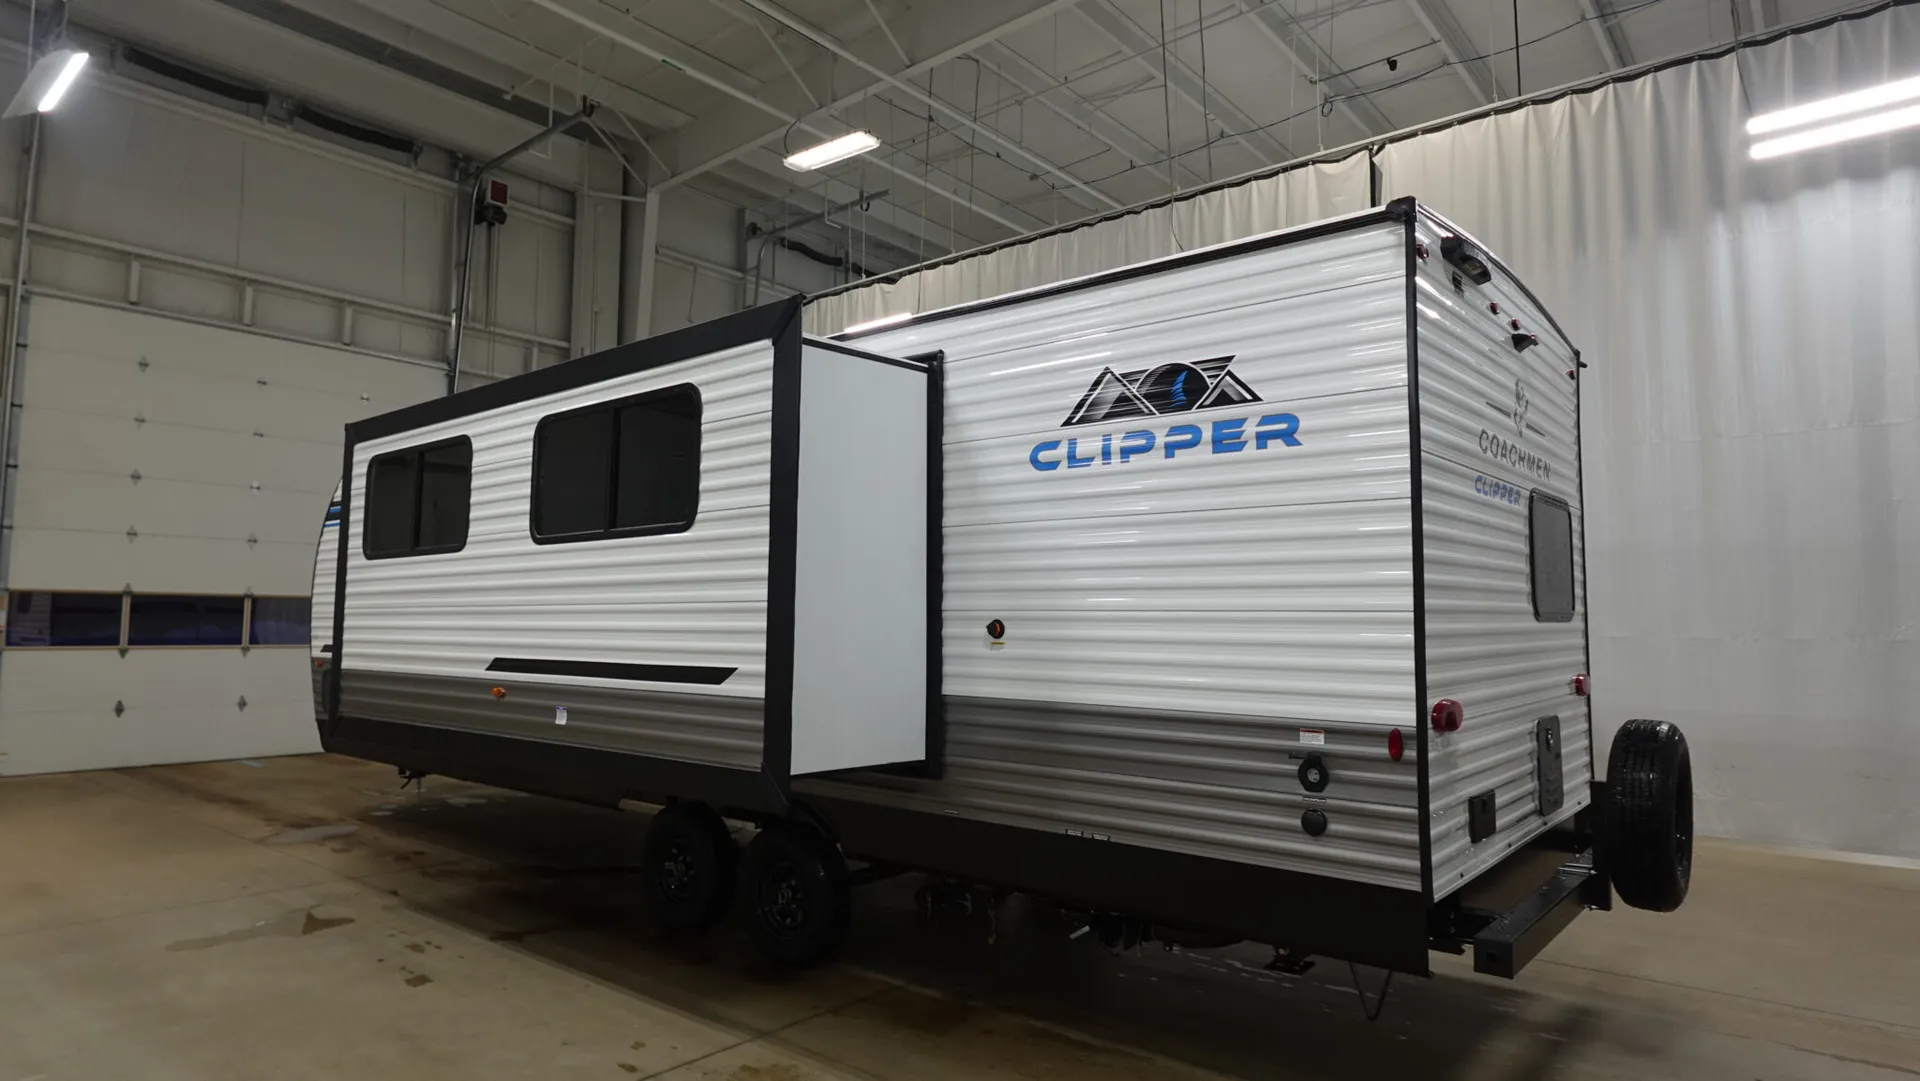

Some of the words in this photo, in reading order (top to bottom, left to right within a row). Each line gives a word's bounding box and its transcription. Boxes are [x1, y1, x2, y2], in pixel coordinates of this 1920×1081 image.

[1029, 412, 1303, 471] CLIPPER
[1479, 428, 1551, 481] COACHMEN
[1474, 475, 1521, 506] CLIPPER
